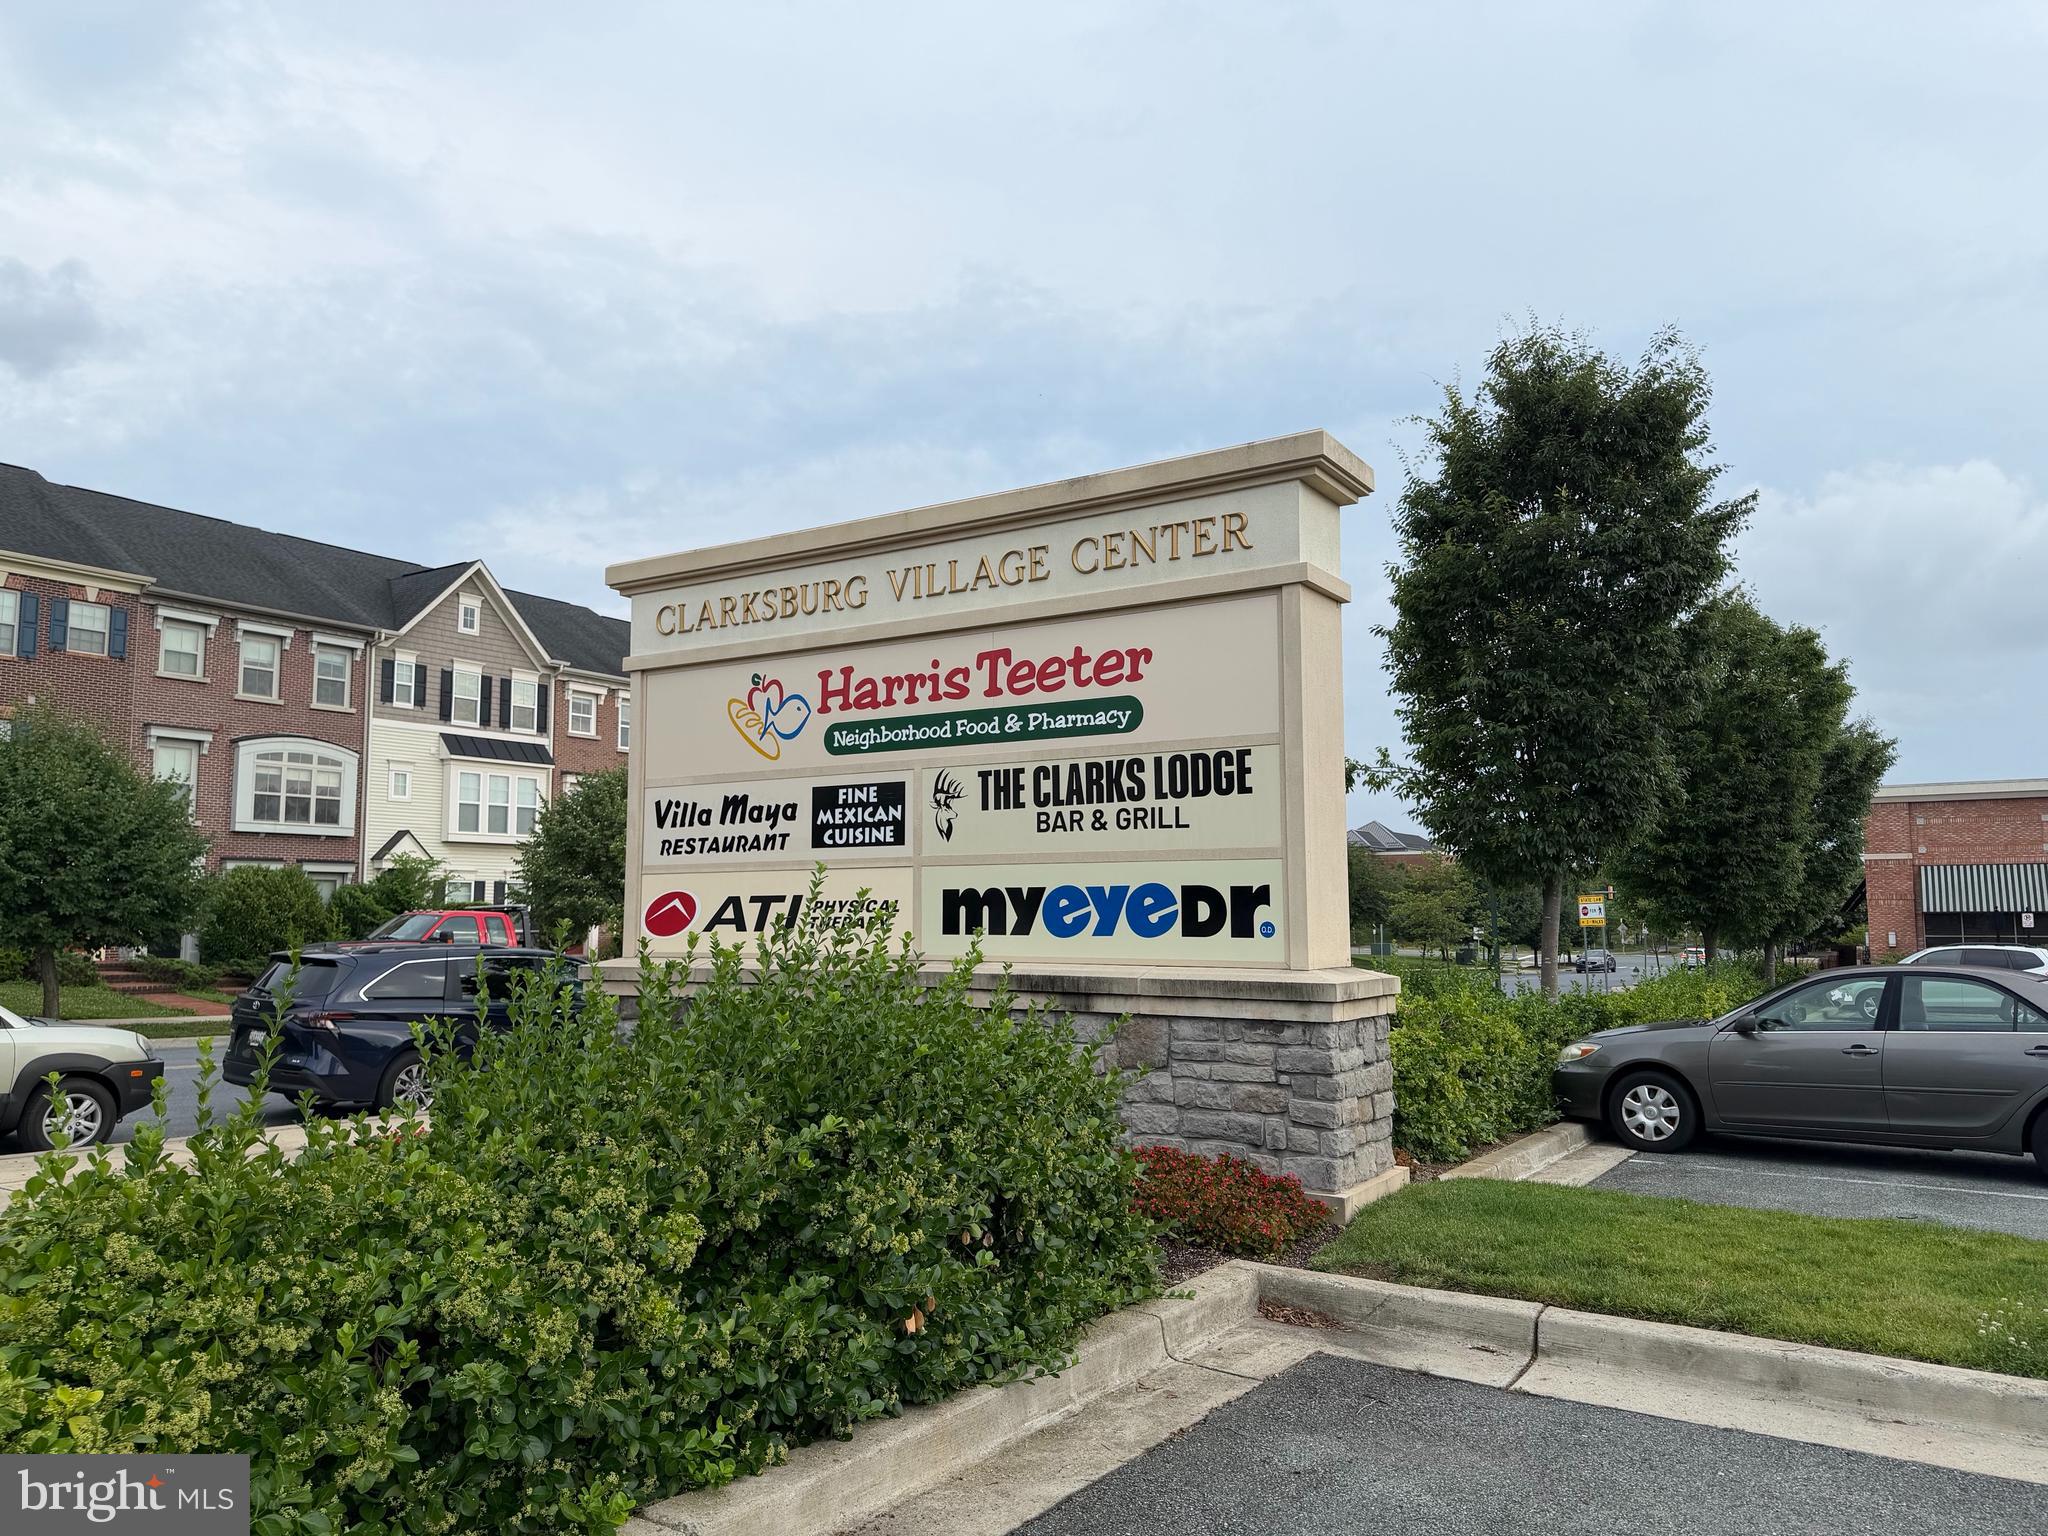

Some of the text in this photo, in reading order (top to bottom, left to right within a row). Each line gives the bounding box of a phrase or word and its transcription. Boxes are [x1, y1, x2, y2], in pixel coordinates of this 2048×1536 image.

[655, 511, 1254, 636] CLARKSBURG VILLAGE CENTER
[817, 645, 1154, 715] Harris Teeter
[833, 708, 1132, 750] Neighborhood Food & Pharmacy
[838, 785, 879, 805] FINE
[977, 748, 1253, 811] THE CLARKS LODGE
[655, 793, 799, 831] Villa Maya
[816, 804, 903, 826] MEXICAN
[1036, 805, 1190, 833] BAR & GRILL
[659, 832, 791, 857] RESTAURANT
[823, 825, 895, 845] CUISINE
[702, 894, 804, 933] ATI
